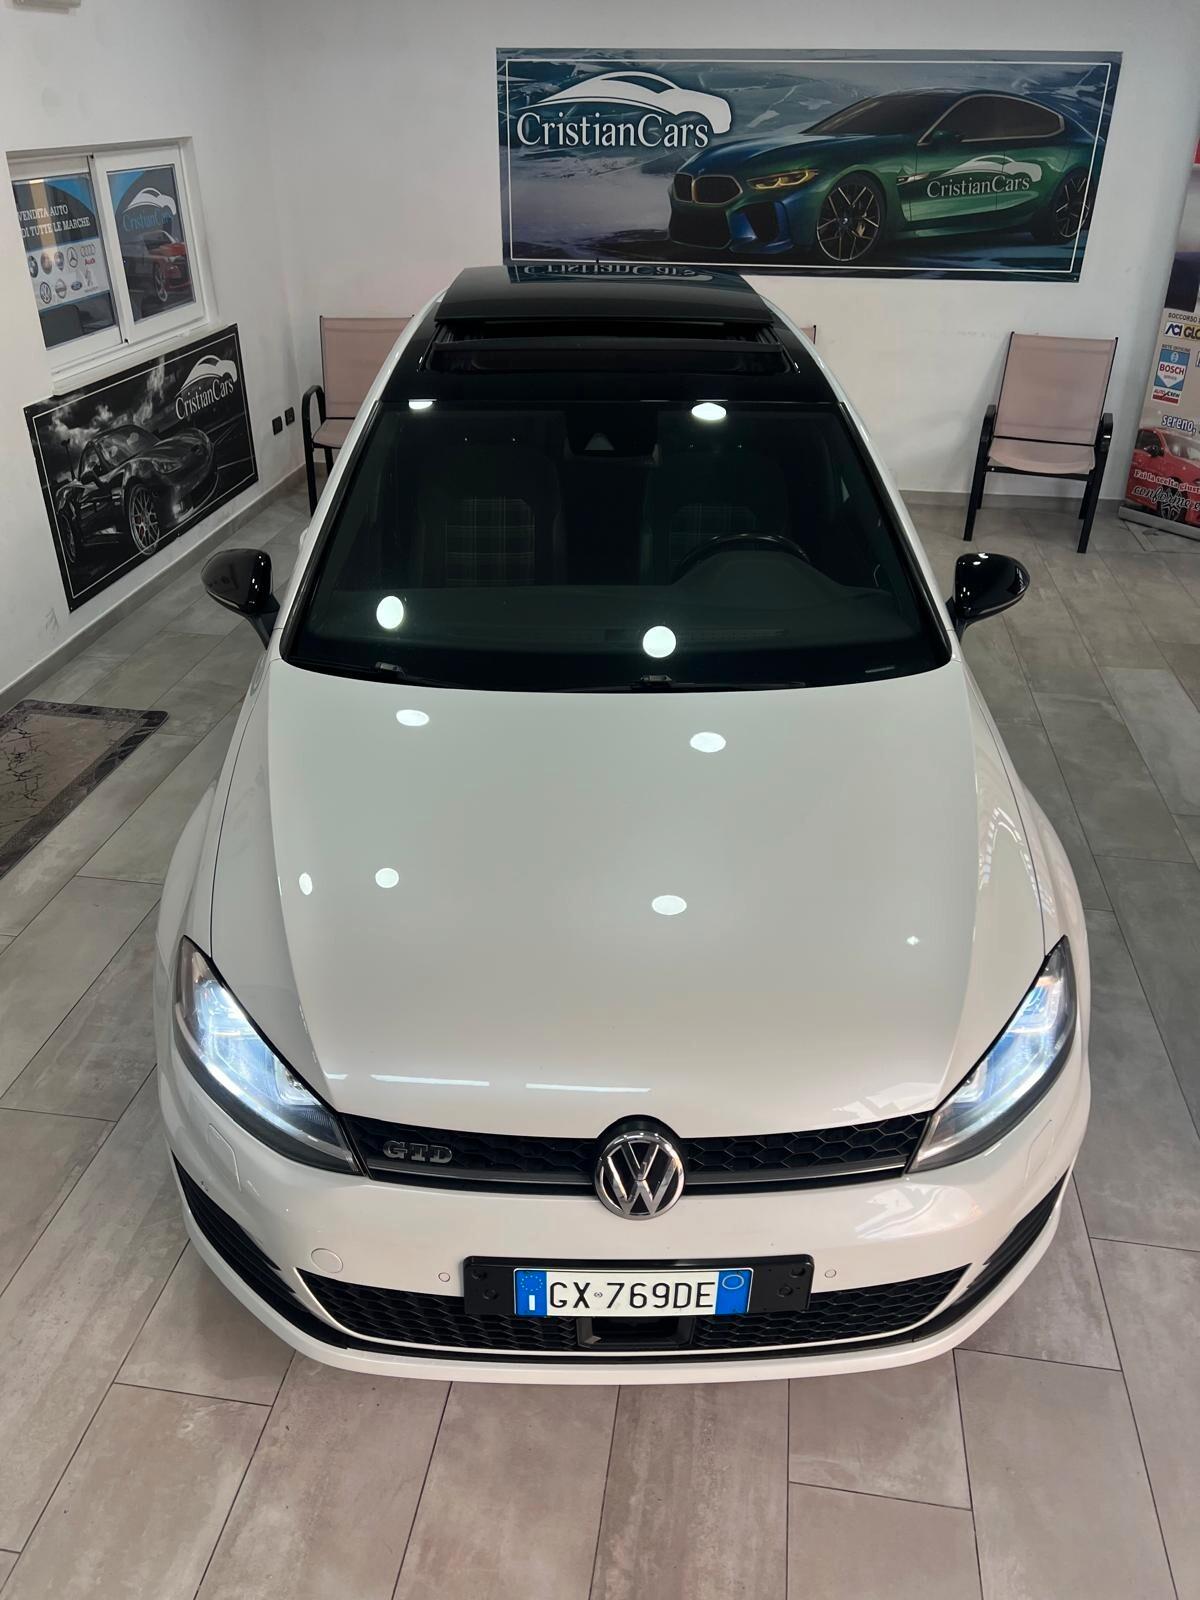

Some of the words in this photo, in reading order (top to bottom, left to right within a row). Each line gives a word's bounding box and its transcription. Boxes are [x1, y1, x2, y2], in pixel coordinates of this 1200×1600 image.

[516, 111, 709, 148] CristianCars
[926, 175, 1030, 198] CristianCars
[50, 204, 69, 217] AUTO
[29, 223, 53, 236] TUTTE
[53, 221, 62, 232] LE
[63, 217, 91, 230] MARCHE
[1159, 363, 1184, 376] BOSCH
[175, 378, 234, 420] CristianCars
[383, 1140, 453, 1164] GTD
[549, 1281, 591, 1309] GX
[606, 1281, 716, 1309] 769DE
